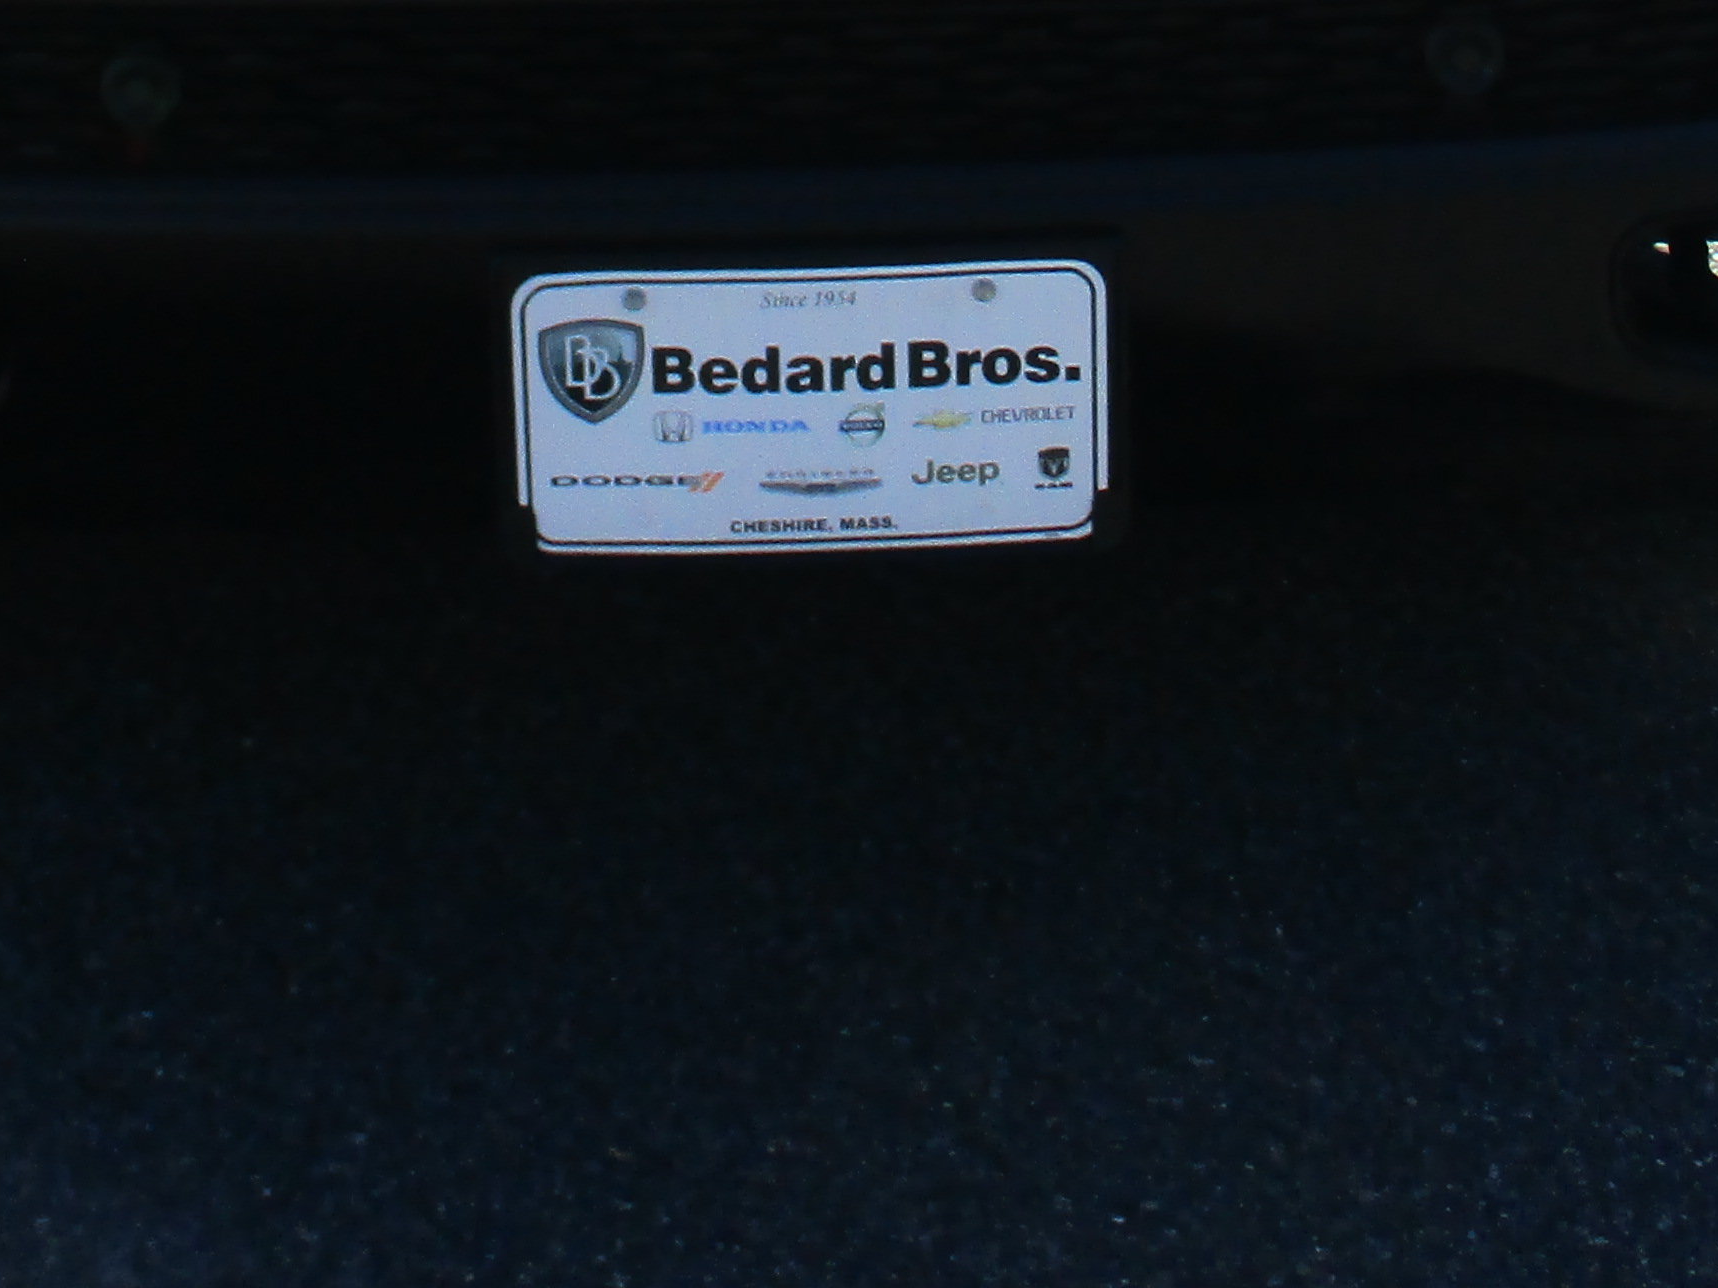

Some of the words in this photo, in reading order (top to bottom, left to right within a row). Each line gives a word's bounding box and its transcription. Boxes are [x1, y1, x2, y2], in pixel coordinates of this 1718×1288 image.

[758, 291, 807, 308] Since
[651, 340, 897, 395] Bedard
[907, 338, 1081, 389] Bros.
[980, 404, 1076, 425] CHEVROLET
[701, 419, 811, 435] HONDA
[550, 473, 699, 488] DODGE
[911, 458, 1001, 486] Jeep
[839, 515, 898, 530] MASS.
